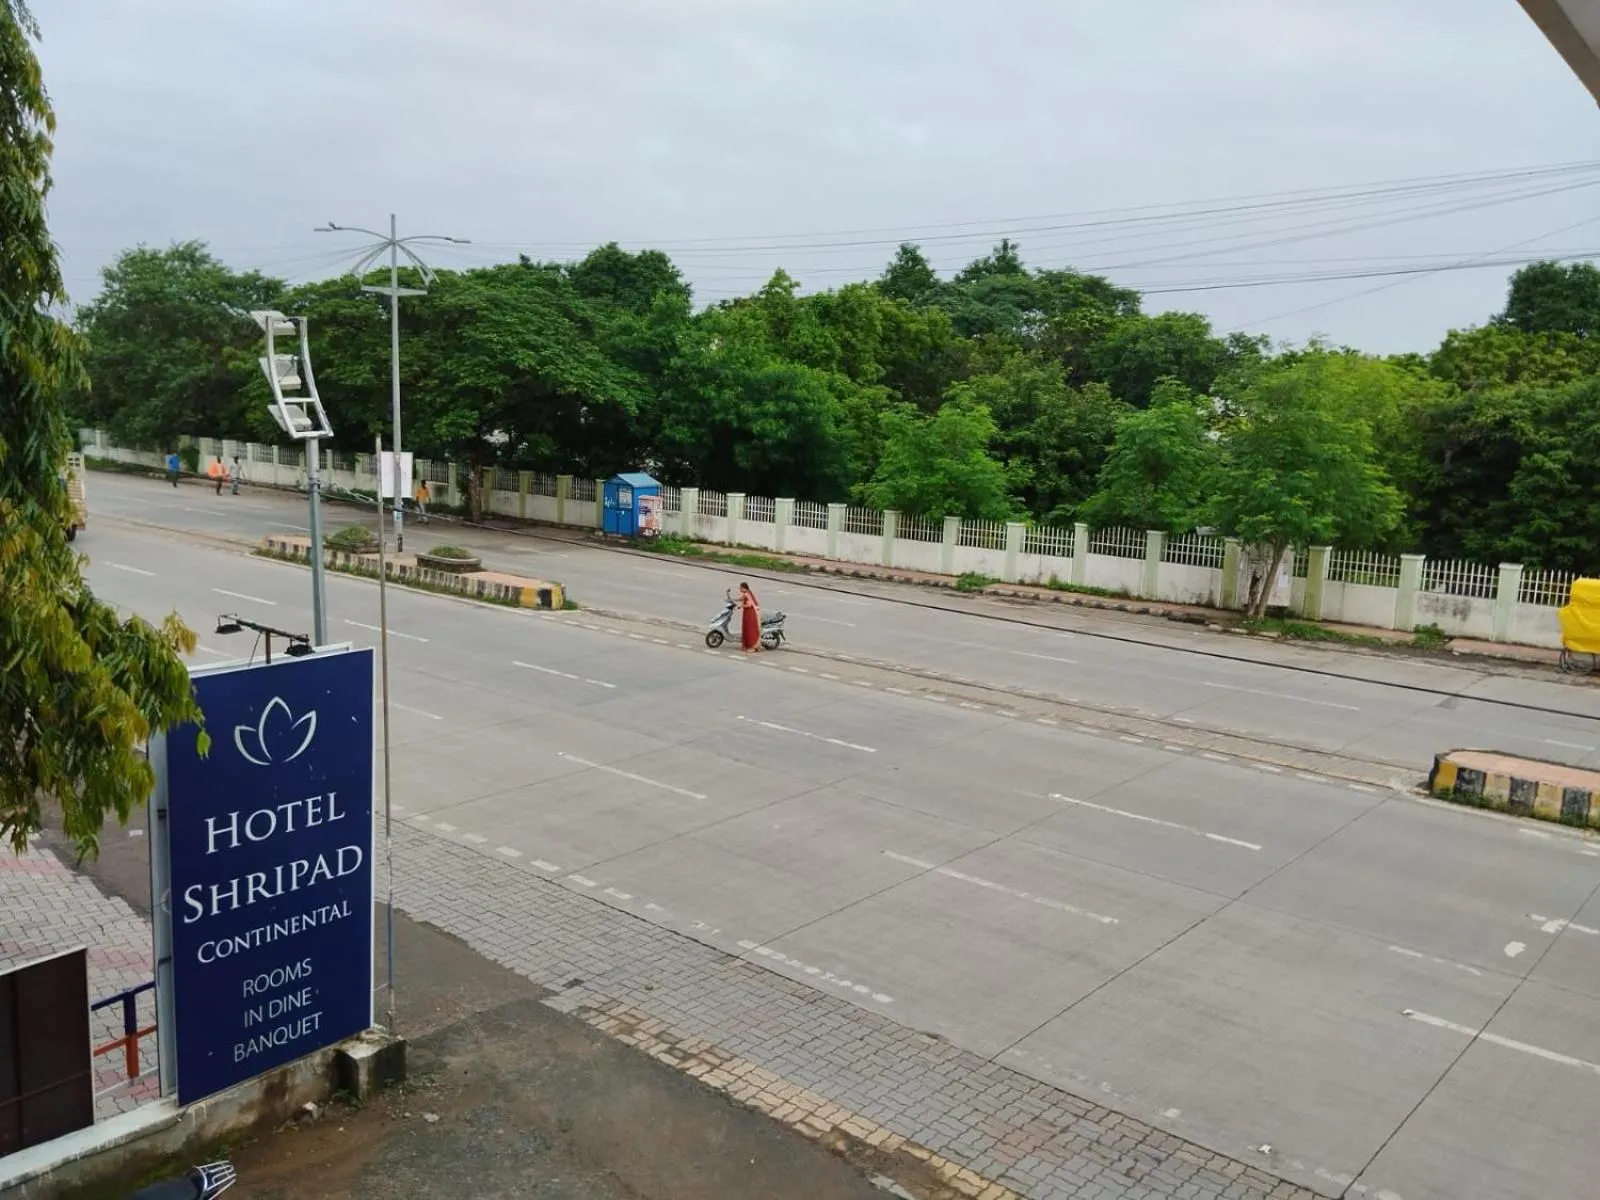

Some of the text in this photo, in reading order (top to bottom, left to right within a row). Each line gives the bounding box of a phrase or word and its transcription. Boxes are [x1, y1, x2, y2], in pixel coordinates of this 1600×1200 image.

[204, 792, 346, 855] HOTEL
[183, 845, 363, 924] SHRIPAD
[197, 900, 352, 964] CONTINENTAL
[243, 958, 312, 998] ROOMS
[244, 987, 312, 1029] IN DINE
[234, 1012, 322, 1063] BANQUET
